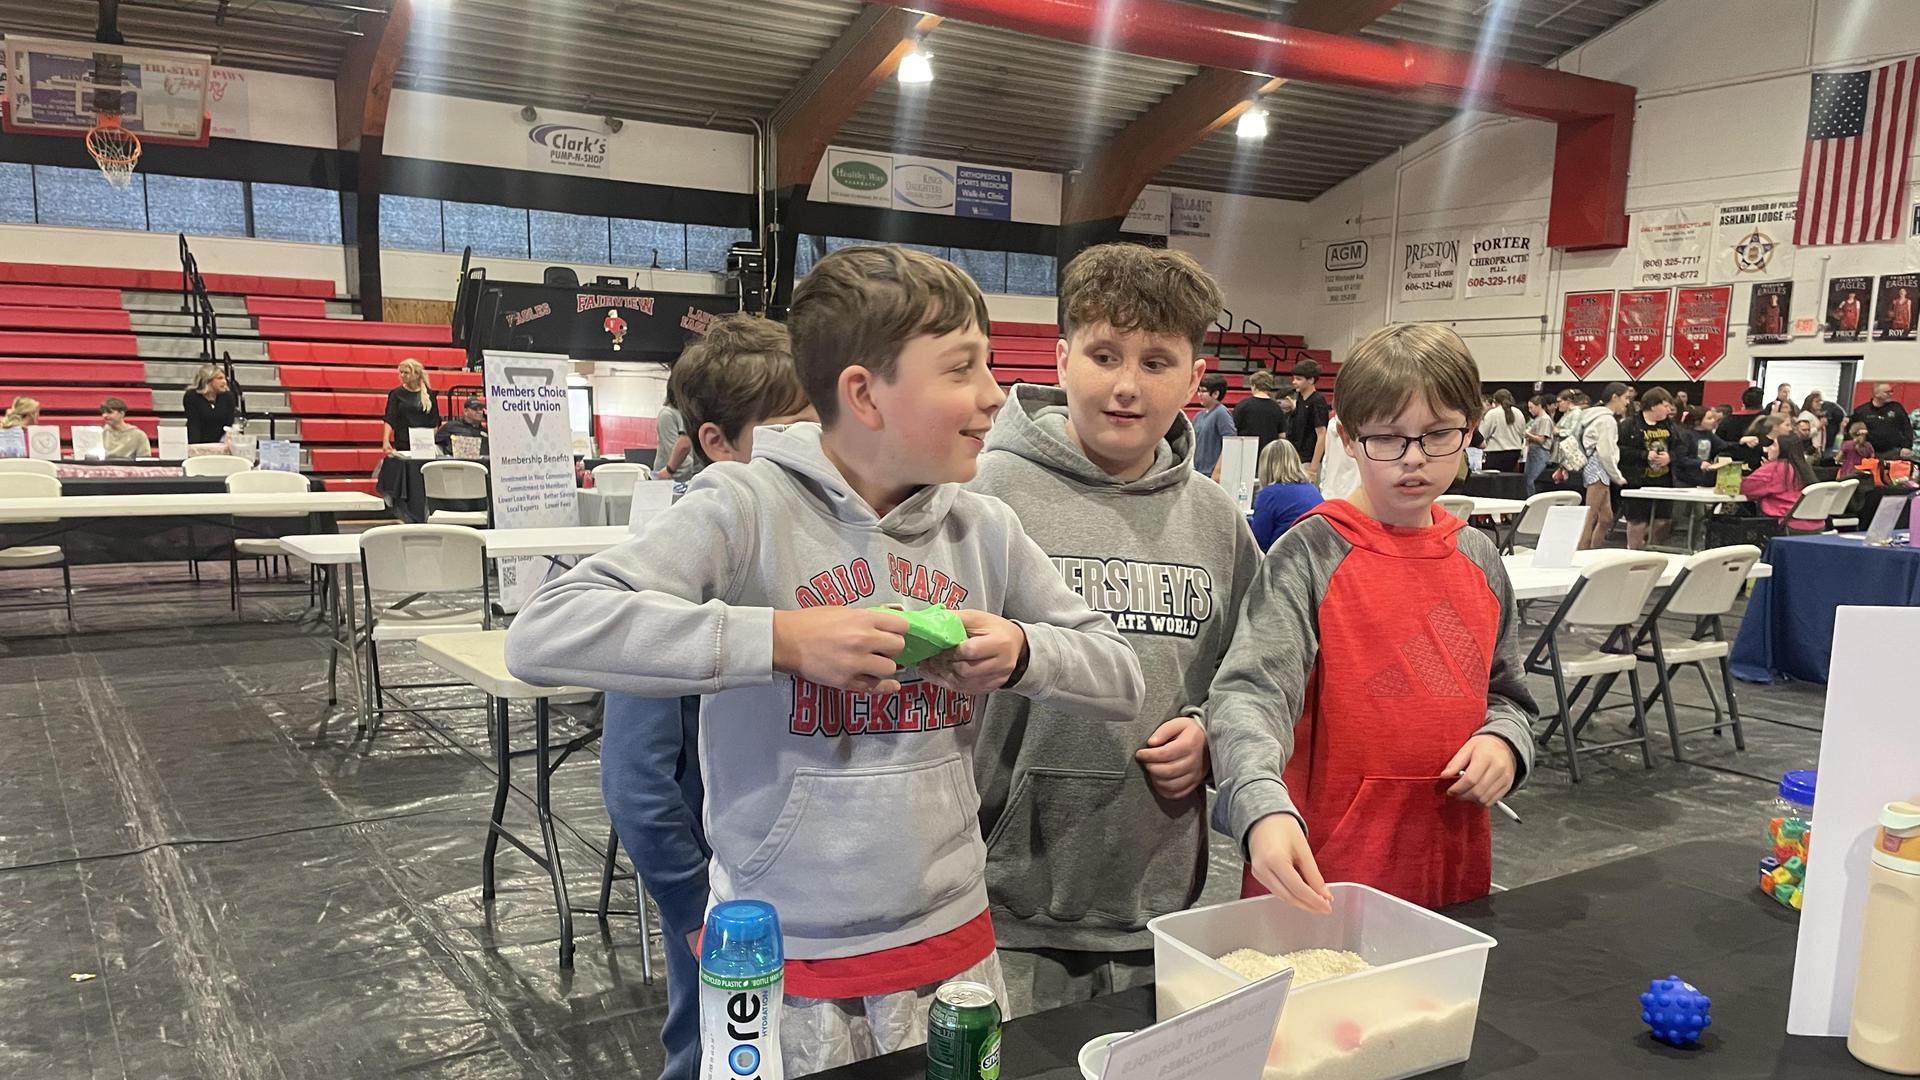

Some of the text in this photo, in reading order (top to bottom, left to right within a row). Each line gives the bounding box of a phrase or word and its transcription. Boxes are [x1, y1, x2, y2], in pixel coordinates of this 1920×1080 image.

[144, 64, 206, 77] TRI-STAT
[552, 134, 606, 154] Clark's
[550, 150, 604, 164] PUMP-N-SHOP
[836, 167, 885, 184] Healthy Way
[960, 170, 1001, 181] ORTHOPEDICS
[957, 178, 1009, 190] SPORTS MEDICINE
[986, 191, 1005, 200] Clinic
[1720, 205, 1750, 214] FRATERNAL
[1750, 203, 1770, 211] ORDER
[1778, 201, 1798, 209] POLIC
[1719, 213, 1756, 226] ASHLAND
[1757, 211, 1784, 223] LODGE
[1472, 236, 1530, 254] PORTER
[1331, 245, 1362, 262] AGM
[1404, 240, 1460, 271] PRESTON
[1469, 253, 1529, 267] CHIROPRACTIC
[1420, 260, 1442, 270] Family
[1407, 269, 1454, 279] Funeral Home
[1642, 273, 1661, 283] (06)
[1834, 281, 1866, 292] EAGLES
[1885, 279, 1919, 289] EAGLES
[576, 293, 655, 316] FAIRVIEW
[1887, 328, 1905, 337] ROY
[491, 385, 567, 398] Members Choice
[502, 400, 561, 412] Credit Union
[501, 454, 570, 465] Membership Benefits
[507, 484, 539, 492] Commitment
[497, 496, 513, 504] Lower
[507, 504, 539, 513] Local Experts
[795, 553, 968, 610] OHIO STATE
[1150, 615, 1199, 637] WORLD
[790, 674, 976, 738] BUCKEYES
[721, 980, 742, 988] PLASTIC
[761, 990, 769, 1038] HYDRATION
[727, 992, 761, 1080] ore
